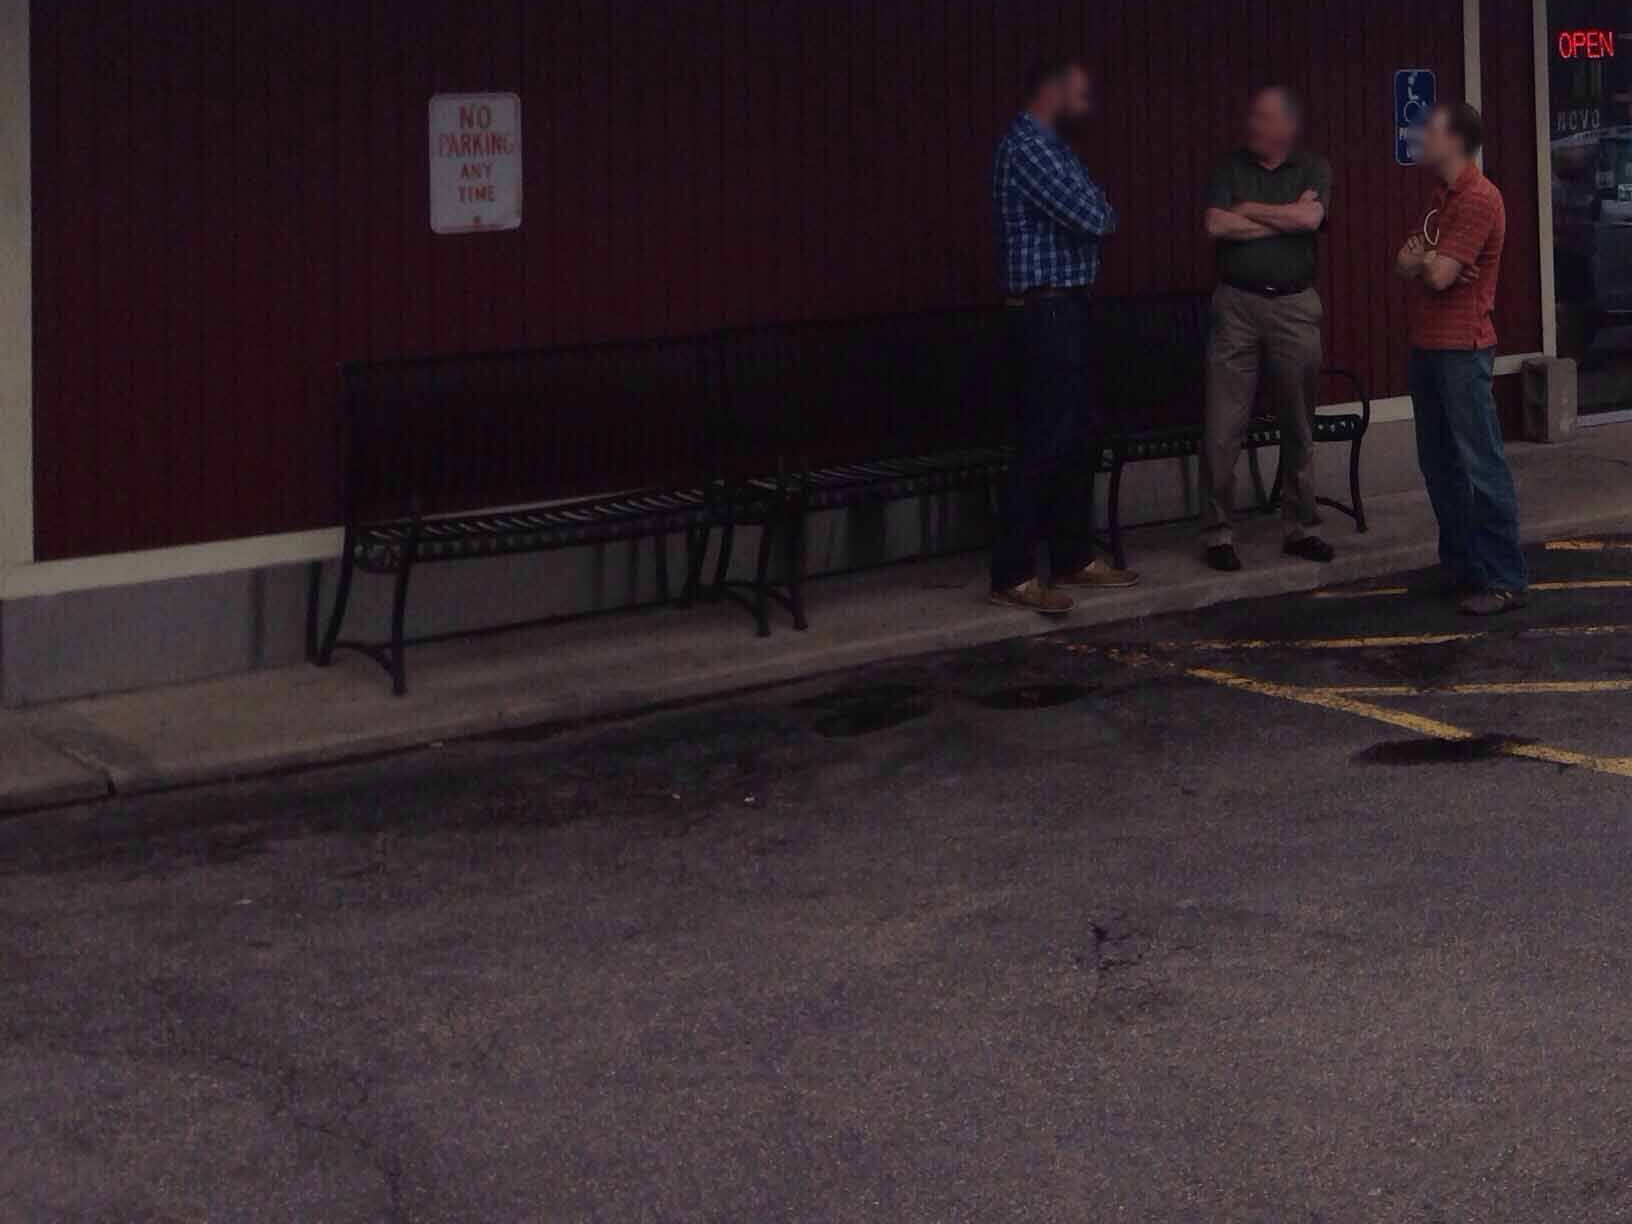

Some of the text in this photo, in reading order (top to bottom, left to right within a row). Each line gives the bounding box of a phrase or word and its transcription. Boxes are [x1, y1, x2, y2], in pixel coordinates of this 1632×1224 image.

[1558, 30, 1615, 59] OPEN
[459, 105, 492, 129] NO
[439, 133, 513, 158] PARKING
[461, 163, 495, 179] ANY
[457, 185, 496, 204] TIME
